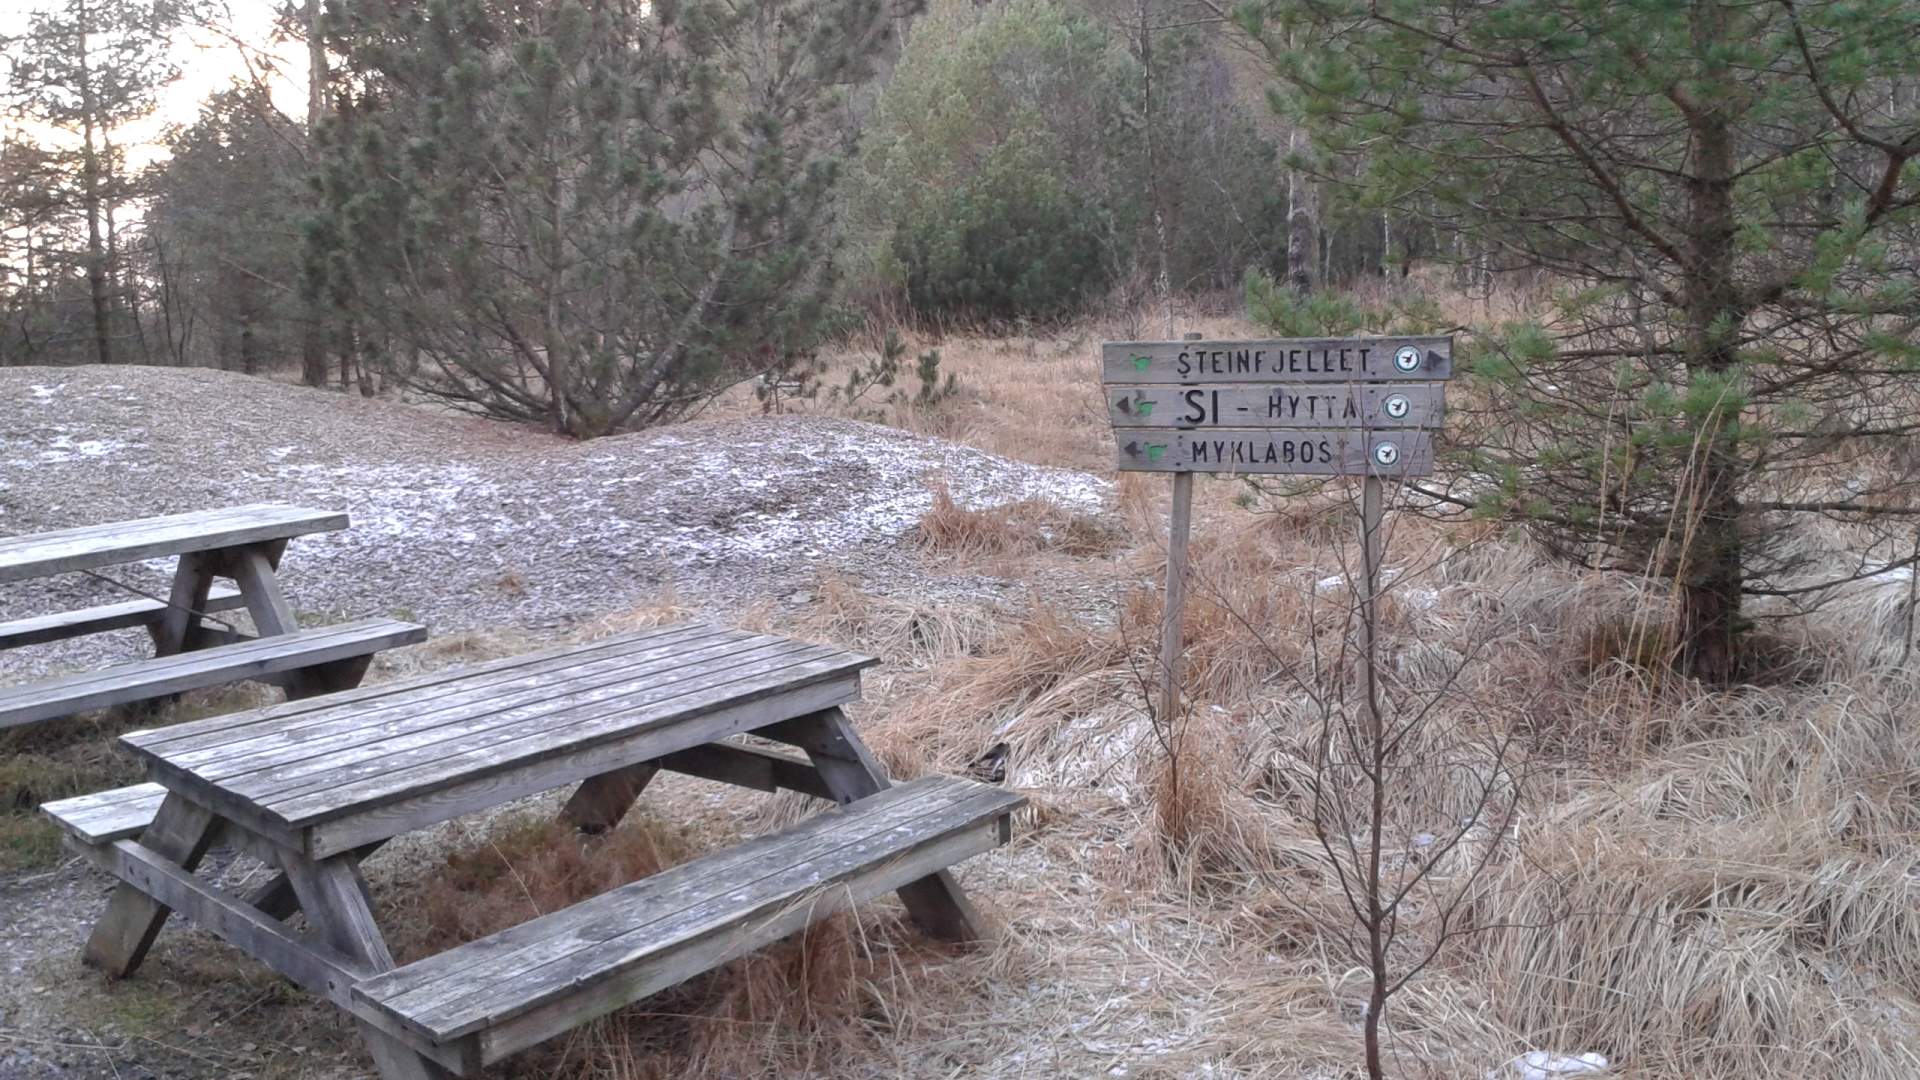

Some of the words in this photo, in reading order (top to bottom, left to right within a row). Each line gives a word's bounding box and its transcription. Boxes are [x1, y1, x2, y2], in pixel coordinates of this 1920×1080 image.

[1177, 349, 1371, 375] STEINFJELLET
[1184, 389, 1219, 425] SI
[1268, 394, 1357, 419] HYTTA
[1191, 440, 1333, 464] MYKLABOS
